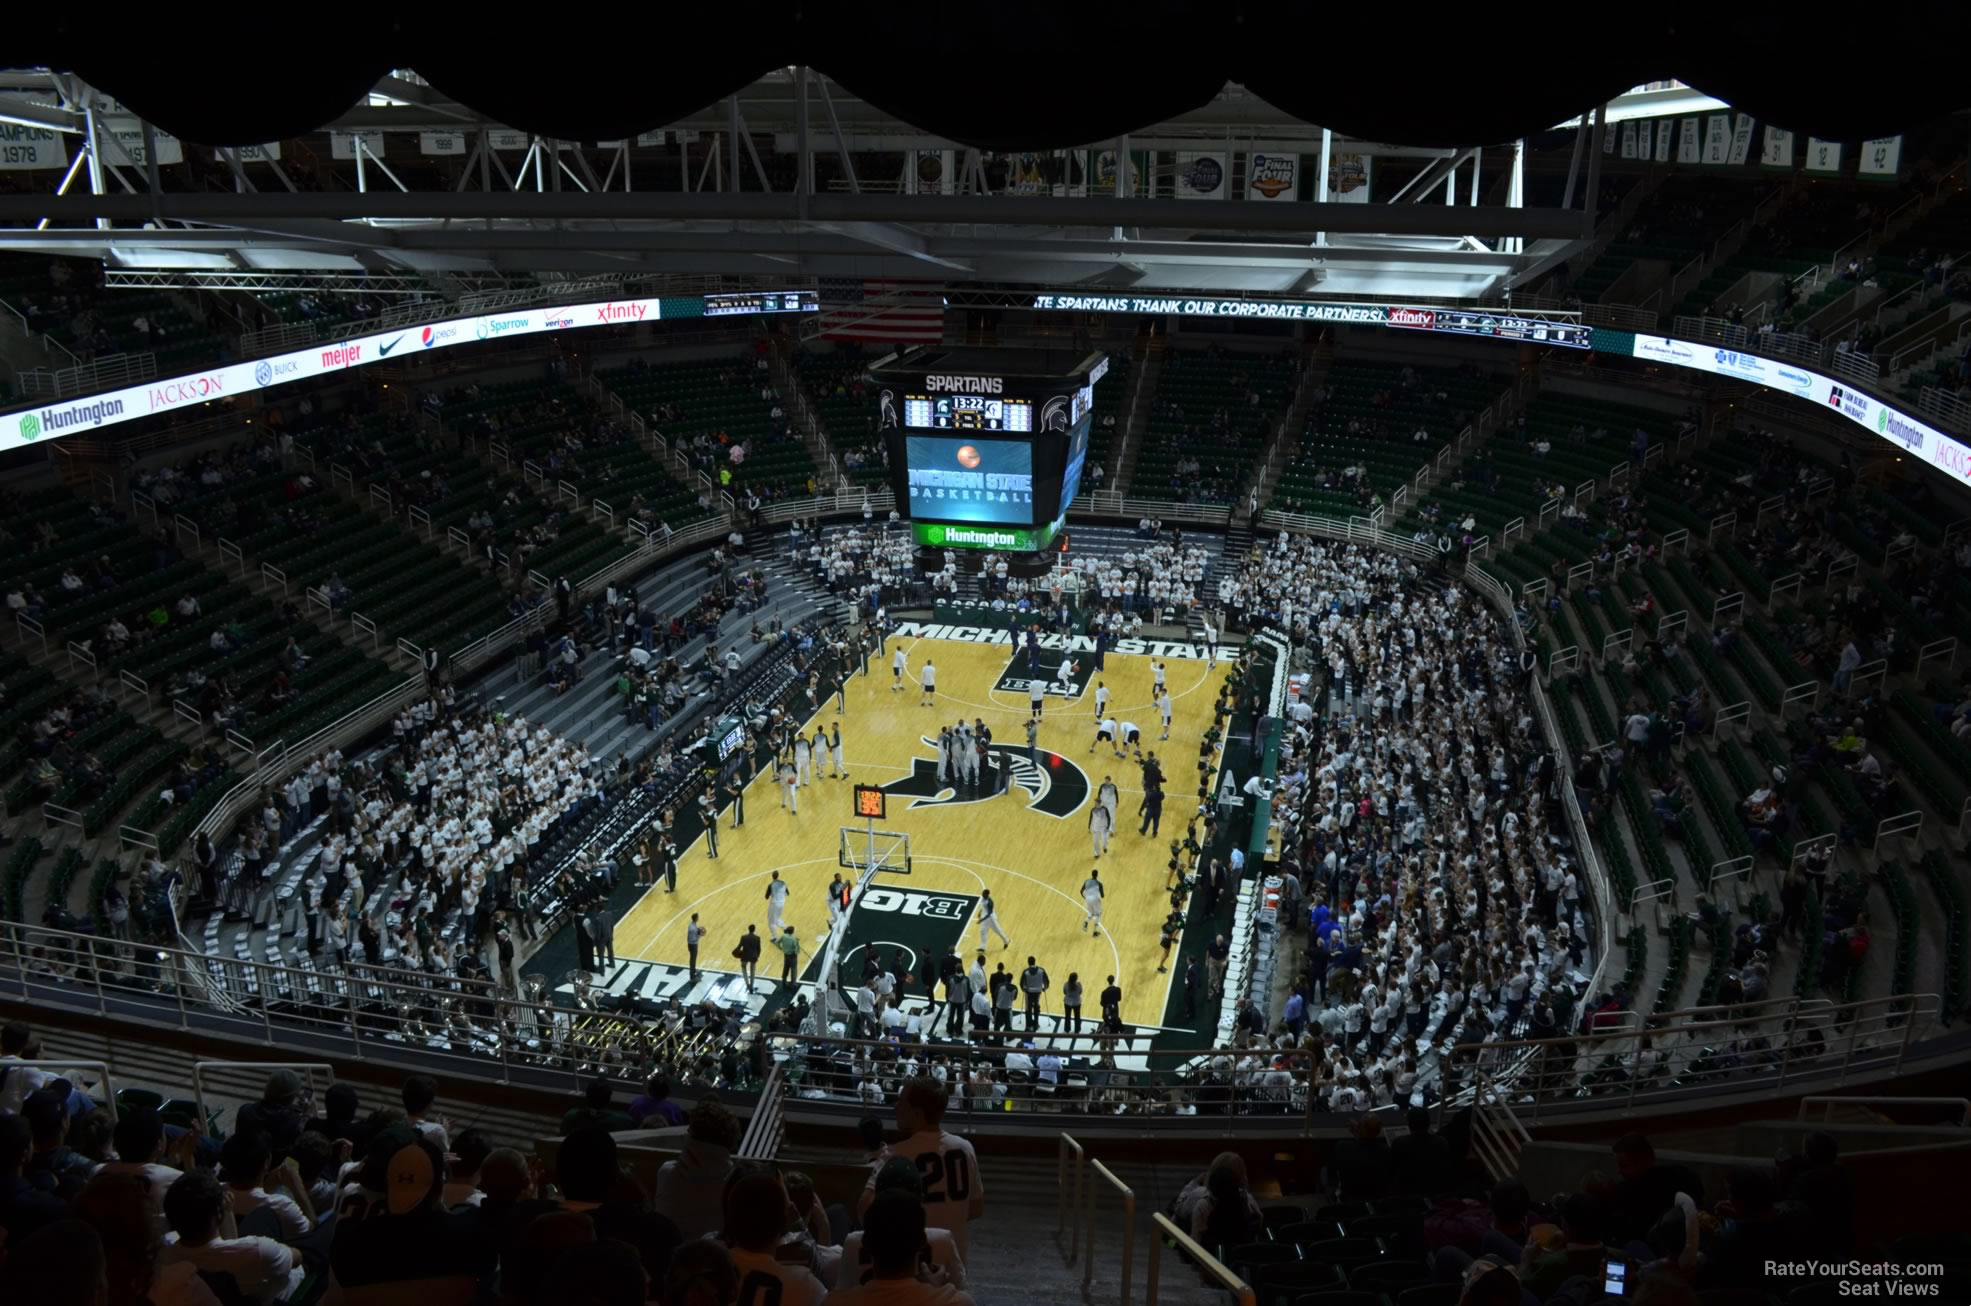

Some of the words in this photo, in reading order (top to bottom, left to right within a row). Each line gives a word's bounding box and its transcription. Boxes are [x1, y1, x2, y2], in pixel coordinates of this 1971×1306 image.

[4, 146, 37, 163] 1978
[1264, 159, 1293, 170] FINAL
[1252, 168, 1293, 183] FOUR
[597, 302, 648, 325] xfinity
[1056, 296, 1128, 311] SPARTANS
[1132, 299, 1180, 313] THANK
[1185, 300, 1216, 315] OUR
[1219, 301, 1303, 319] CORPORATE
[490, 318, 528, 335] Sparrow
[545, 317, 574, 328] verizon
[1391, 311, 1432, 327] xfinity
[436, 327, 457, 342] pepsi
[322, 341, 361, 368] meijer
[275, 361, 298, 376] BUICK
[148, 374, 225, 412] JACKSON
[926, 375, 1003, 394] SPARTANS
[954, 398, 984, 409] 13:22
[42, 399, 124, 432] Huntington
[1887, 412, 1924, 449] Huntington
[986, 473, 1032, 492] STATE
[910, 488, 1032, 503] BASKETBALL
[945, 528, 1015, 547] Huntington
[1114, 639, 1240, 661] STATE
[916, 1150, 969, 1202] 20
